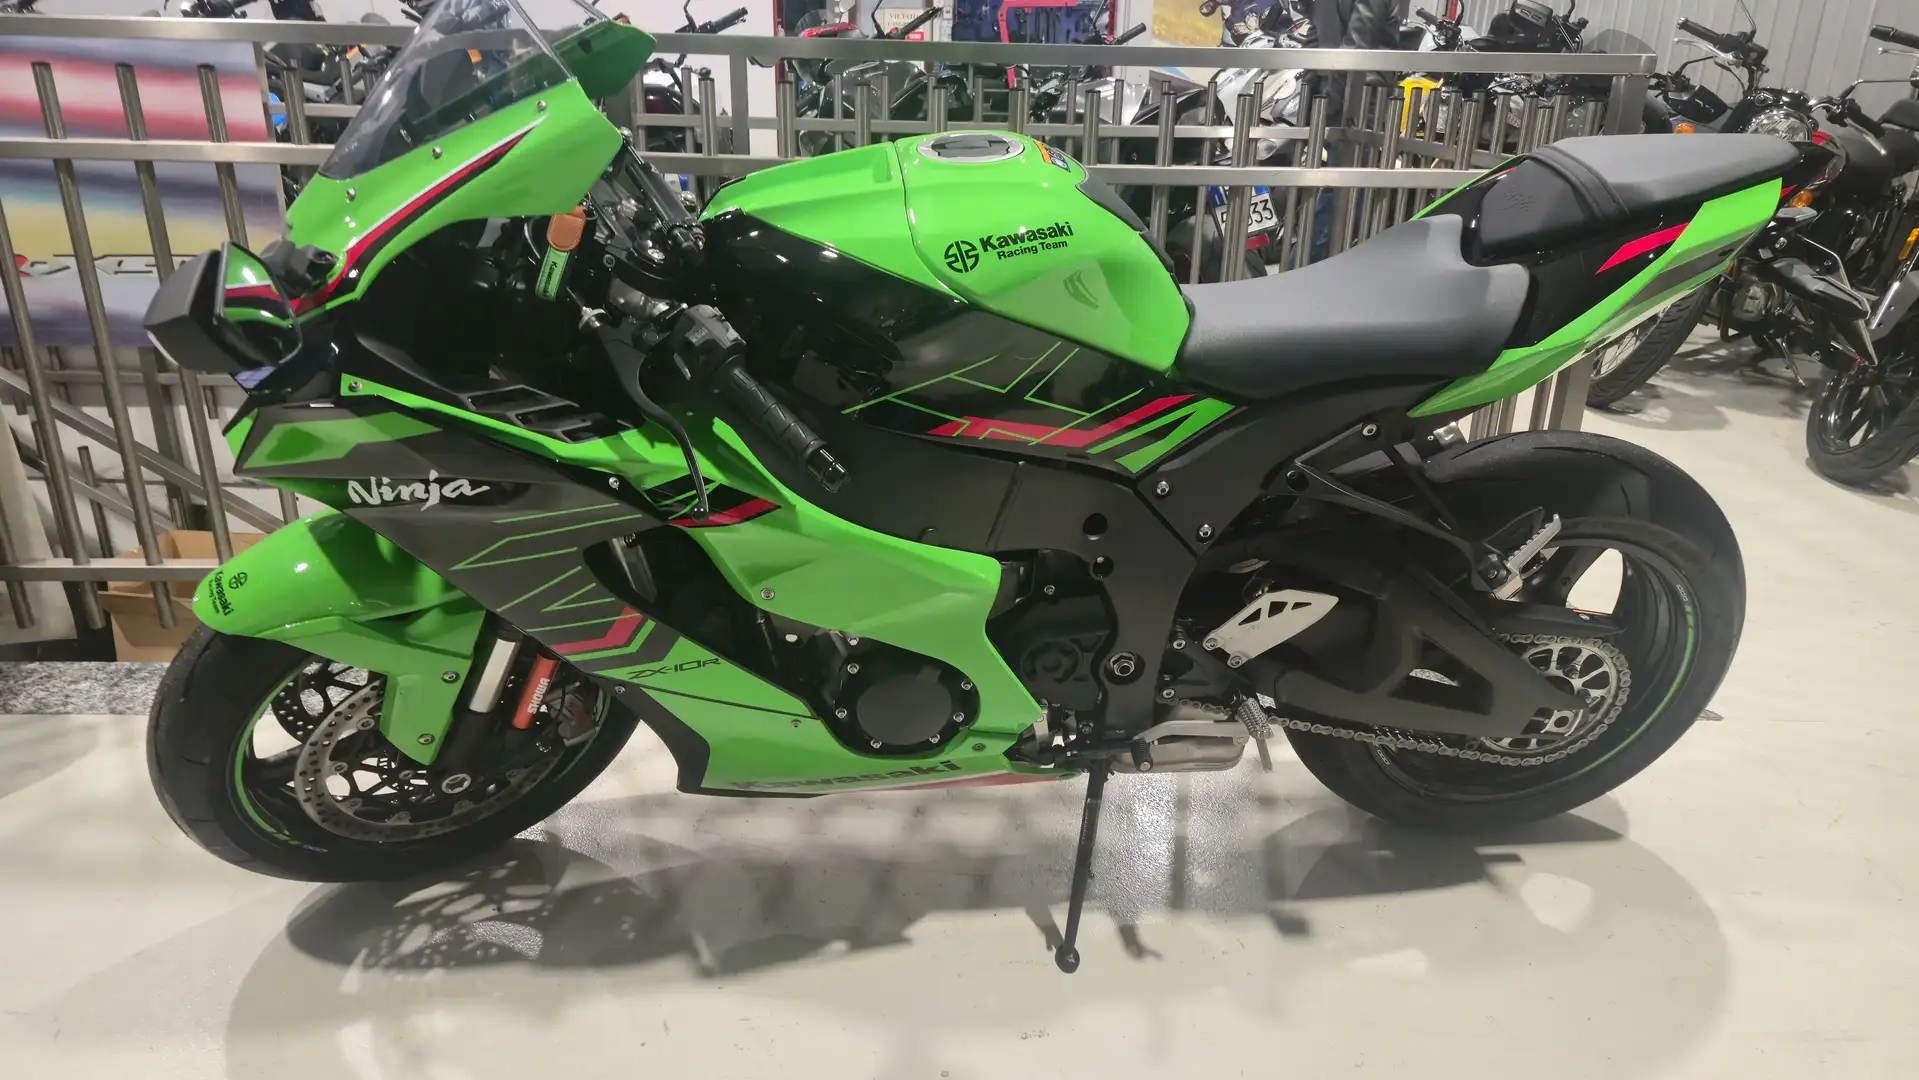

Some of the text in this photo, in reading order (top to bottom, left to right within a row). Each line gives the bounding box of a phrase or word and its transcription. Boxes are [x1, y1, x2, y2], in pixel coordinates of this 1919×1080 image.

[979, 221, 1073, 252] Kawasaki
[996, 240, 1068, 260] Racing Team
[347, 469, 491, 512] Ninja
[215, 570, 234, 616] Kawasaki
[626, 658, 721, 680] ZX-10R
[527, 677, 551, 715] SHOWA
[729, 760, 962, 789] Kawasaki
